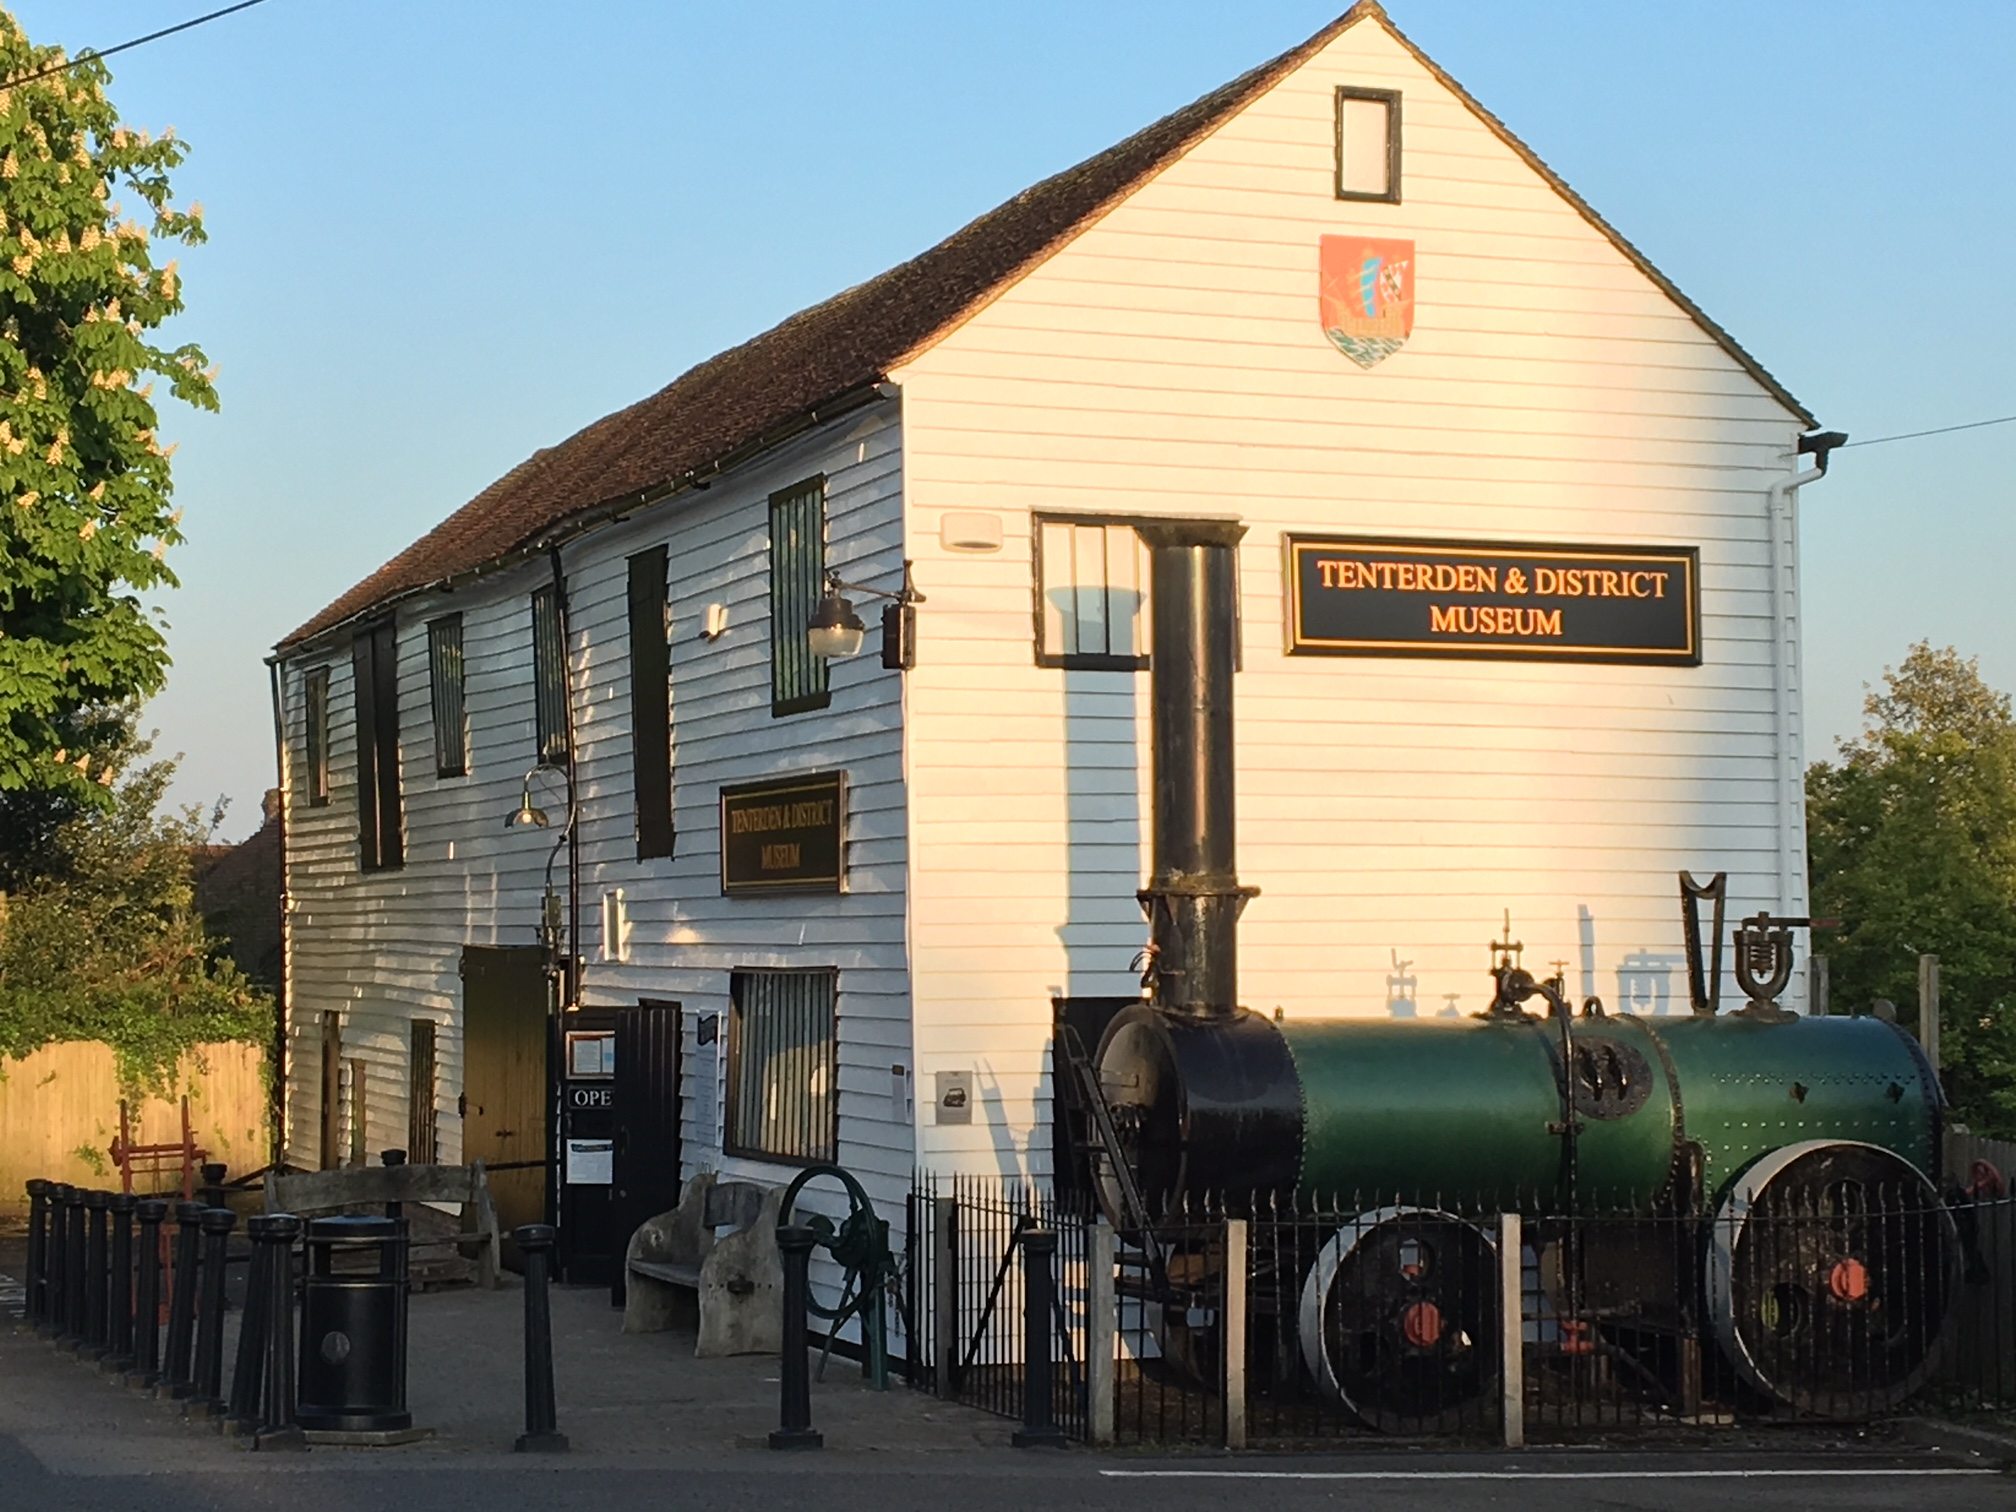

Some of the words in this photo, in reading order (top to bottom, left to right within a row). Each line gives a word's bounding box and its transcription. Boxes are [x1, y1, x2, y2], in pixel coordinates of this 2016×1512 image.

[1317, 560, 1497, 593] TENTERDEN
[1504, 567, 1528, 595] &
[1535, 568, 1668, 598] DISTRICT
[1430, 605, 1563, 635] MUSEUM
[731, 805, 782, 833] TENTERDEN
[791, 799, 833, 828] DISTRICT
[761, 843, 801, 870] MUSEUM
[574, 1089, 614, 1106] OPE
